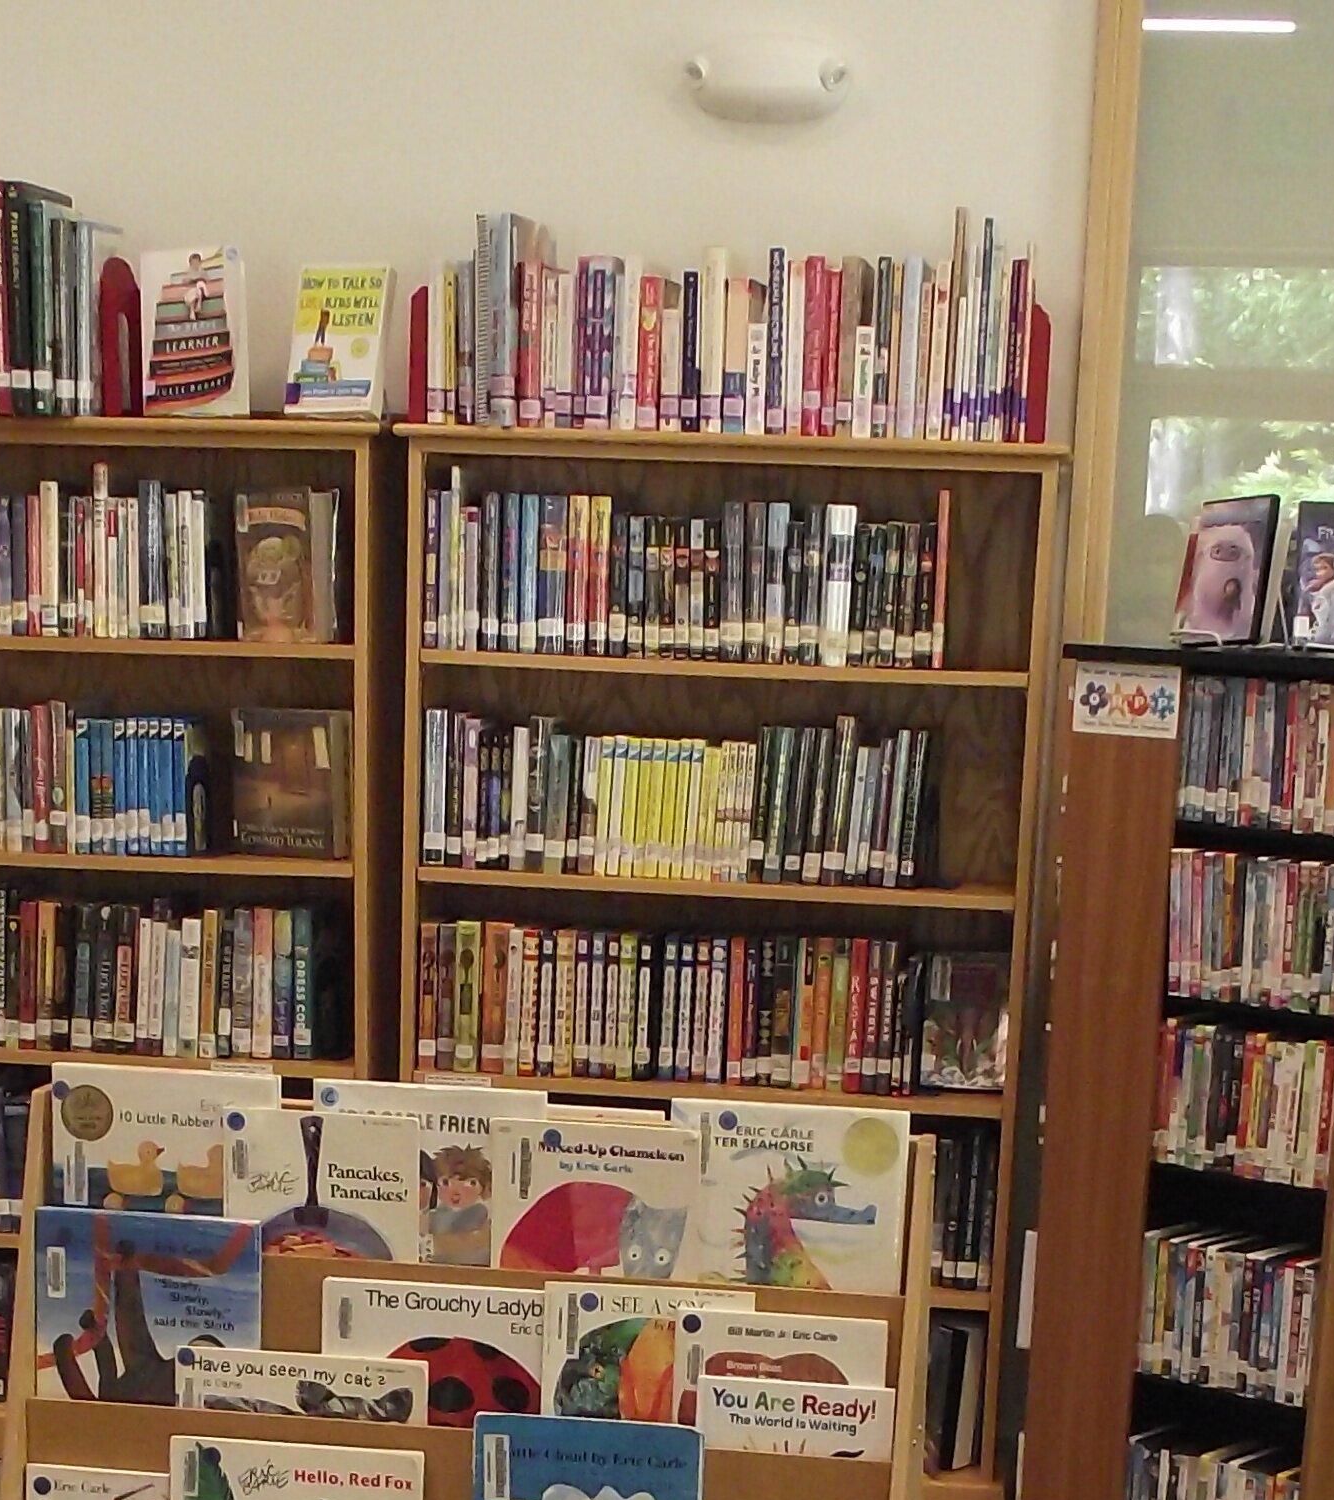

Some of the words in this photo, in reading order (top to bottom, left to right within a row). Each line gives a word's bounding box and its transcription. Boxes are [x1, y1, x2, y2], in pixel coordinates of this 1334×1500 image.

[332, 312, 375, 327] LISTEN
[119, 1110, 132, 1124] 10
[136, 1111, 167, 1125] Little
[171, 1114, 212, 1128] Rubber
[735, 1126, 765, 1137] ERIC
[770, 1127, 814, 1140] CARLE
[611, 1144, 685, 1162] Chameleon
[742, 1139, 814, 1152] SEAHORSE
[327, 1163, 404, 1184] Pancakes,
[330, 1183, 409, 1203] Pancakes!
[365, 1288, 401, 1310] The
[404, 1291, 481, 1317] Grouchy
[653, 1298, 662, 1314] A
[154, 1316, 176, 1327] said
[203, 1320, 235, 1331] Sloth
[510, 1322, 531, 1335] Eric
[745, 1326, 775, 1338] Martin
[792, 1330, 811, 1340] Eric
[813, 1331, 838, 1342] Carle
[192, 1356, 231, 1373] Have
[236, 1362, 264, 1377] you
[269, 1363, 307, 1378] seen
[314, 1368, 337, 1386] my
[712, 1387, 749, 1410] You
[755, 1390, 795, 1413] Are
[801, 1394, 877, 1422] Ready!
[730, 1412, 751, 1427] The
[754, 1414, 792, 1430] World
[808, 1419, 857, 1436] Waiting
[591, 1452, 607, 1466] by
[613, 1452, 644, 1467] Eric
[647, 1455, 687, 1469] Carle
[82, 1480, 110, 1495] Carle
[294, 1468, 345, 1488] Hello,
[349, 1472, 381, 1488] Red
[384, 1474, 413, 1490] Fox
